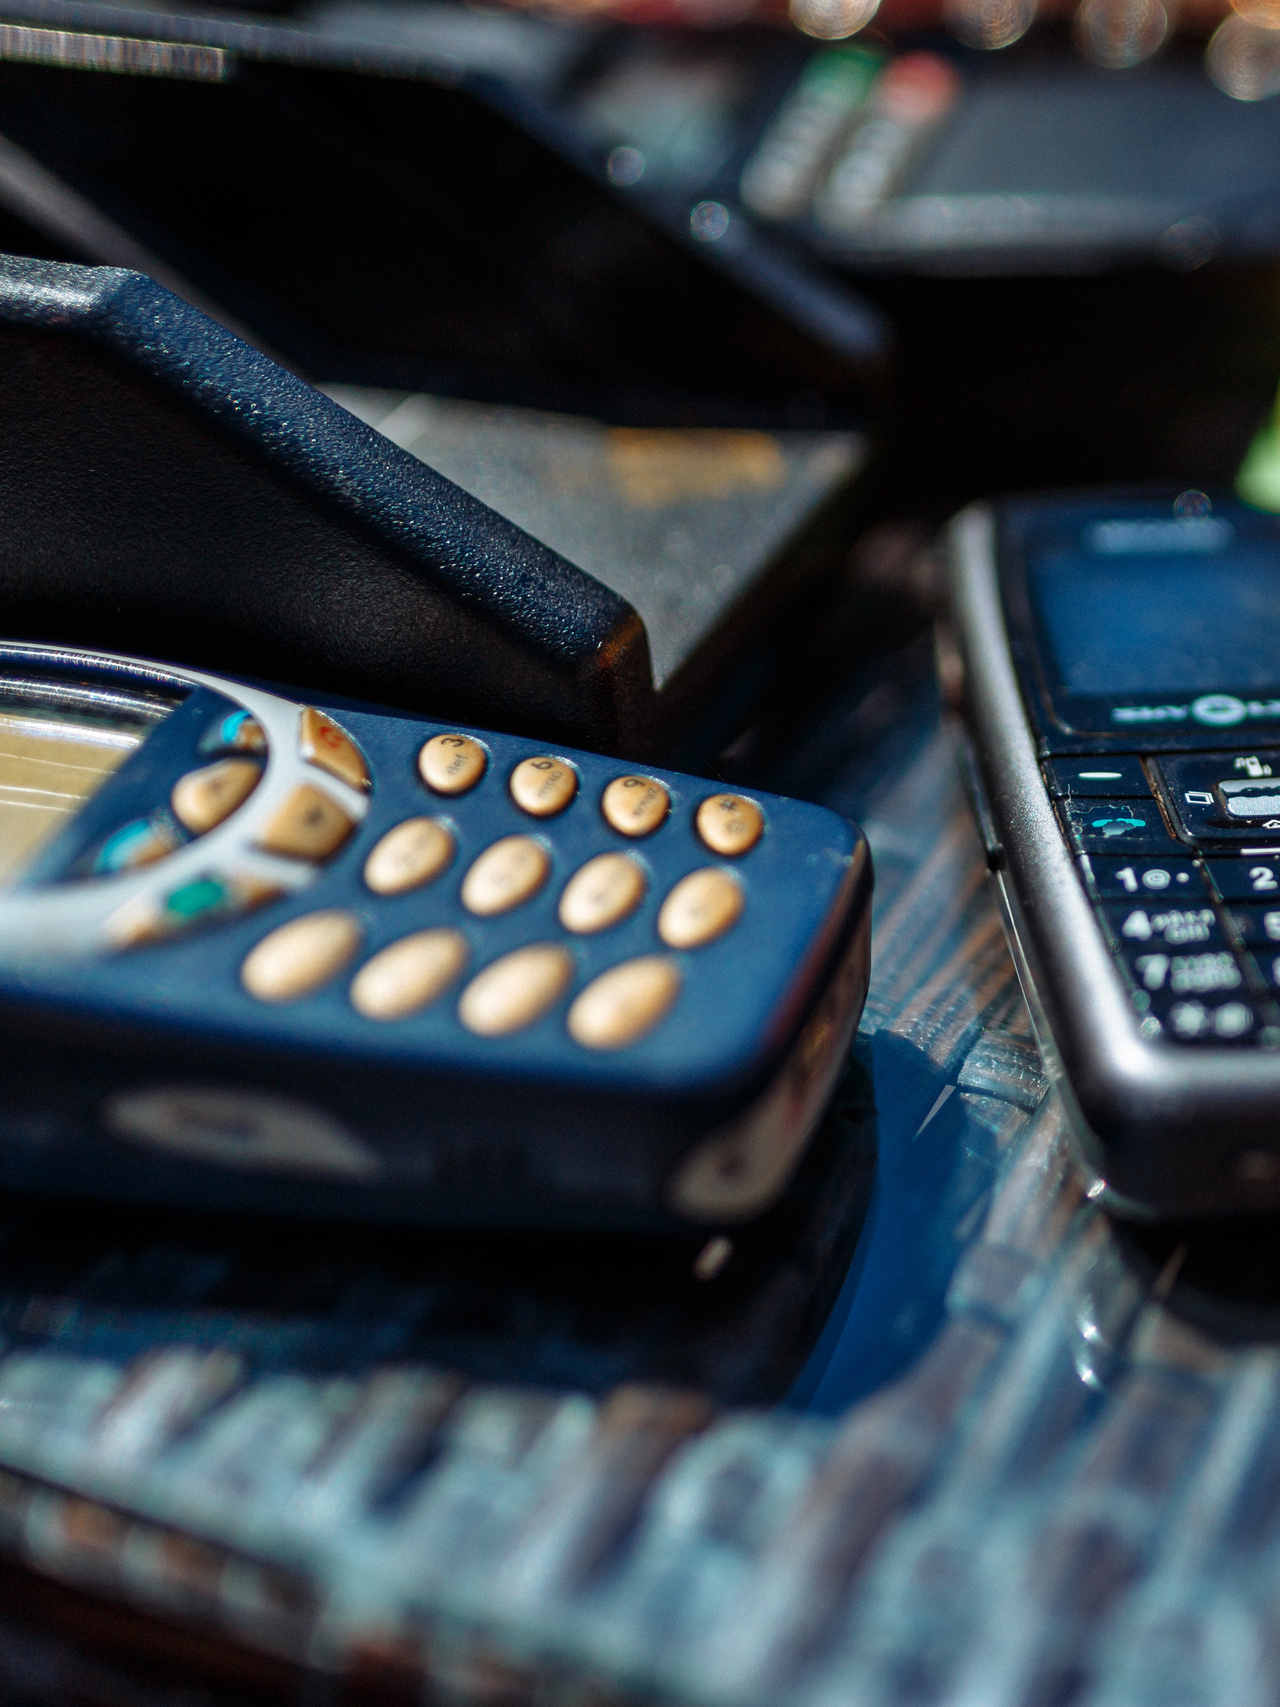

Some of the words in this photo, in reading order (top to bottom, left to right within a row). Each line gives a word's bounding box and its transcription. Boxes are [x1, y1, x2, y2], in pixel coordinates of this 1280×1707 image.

[440, 736, 465, 748] 3
[531, 760, 554, 771] 6
[622, 778, 647, 789] 9
[1249, 866, 1278, 891] 2
